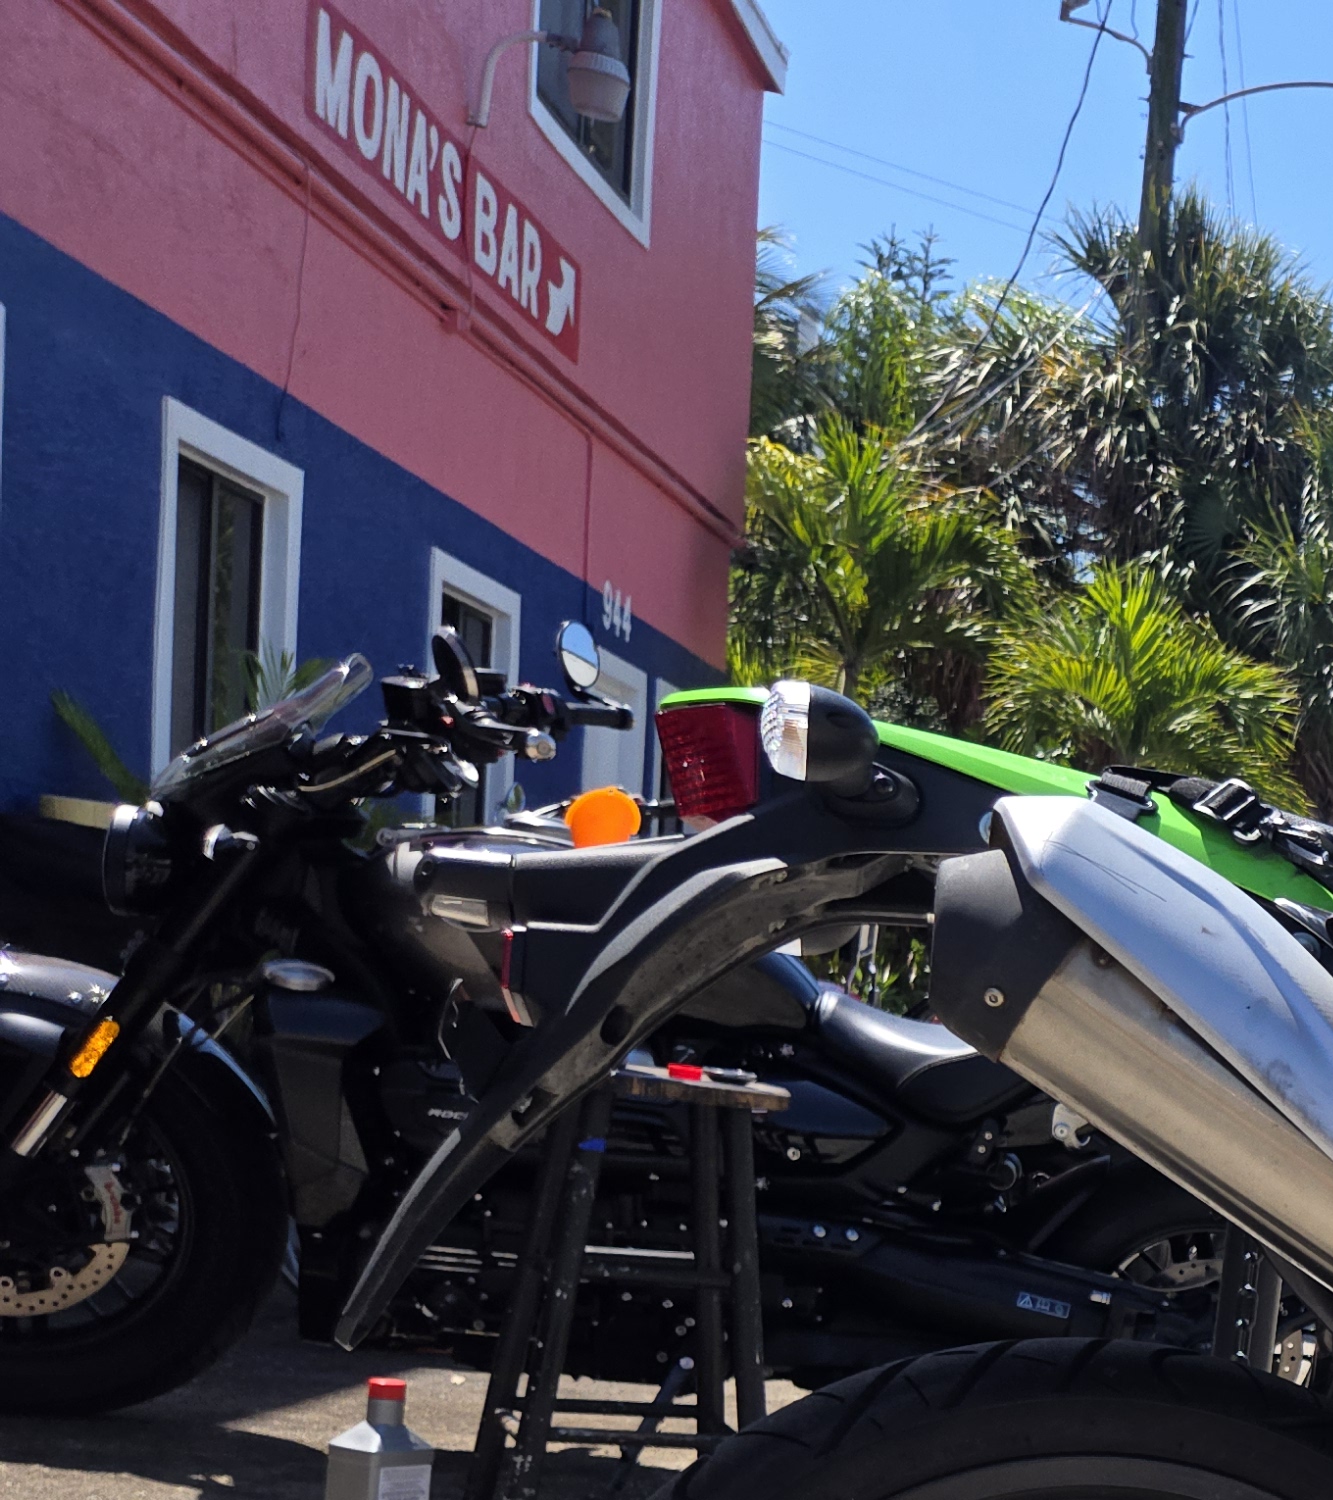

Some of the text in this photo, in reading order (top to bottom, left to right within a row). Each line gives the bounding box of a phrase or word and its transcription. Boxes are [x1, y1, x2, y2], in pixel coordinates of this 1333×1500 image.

[315, 8, 542, 319] MONA'S BAR
[602, 579, 632, 643] 944
